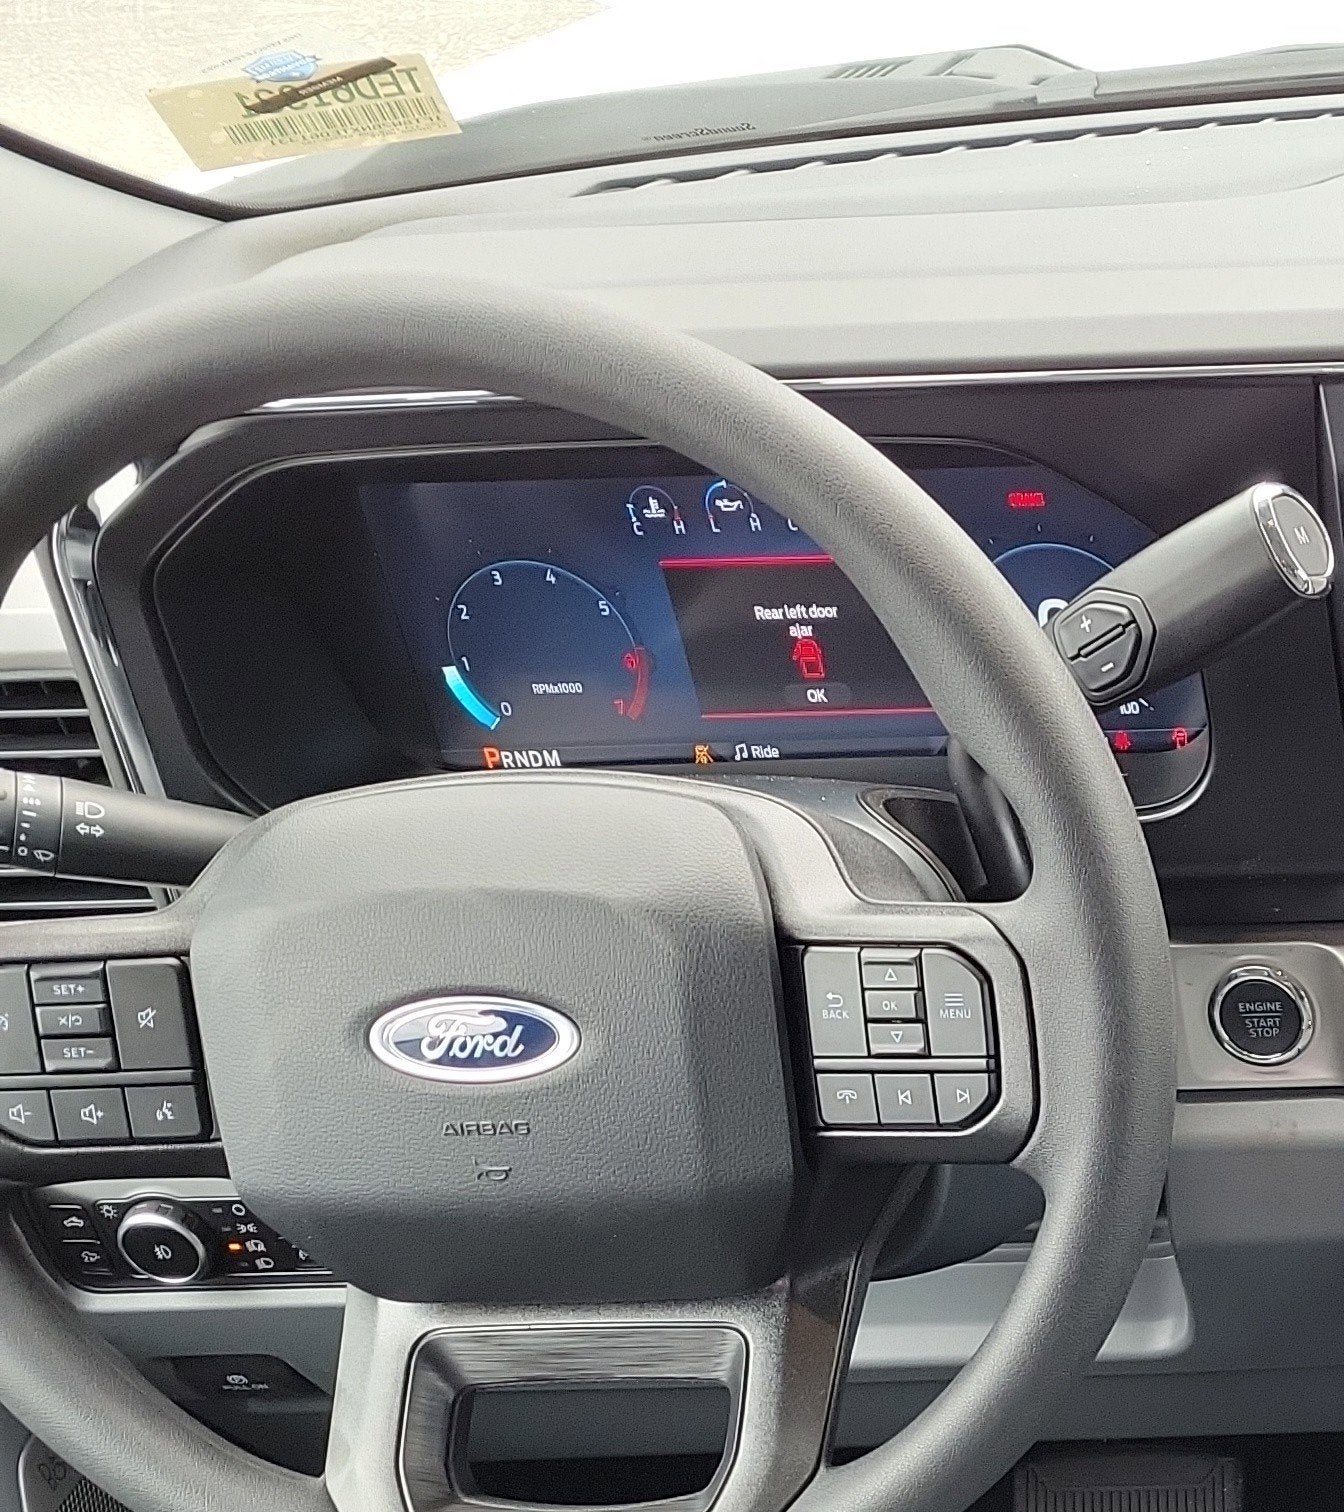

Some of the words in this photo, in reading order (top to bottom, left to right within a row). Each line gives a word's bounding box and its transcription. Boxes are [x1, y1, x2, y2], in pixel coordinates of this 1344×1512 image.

[1294, 526, 1310, 544] M
[491, 570, 502, 585] 3
[546, 571, 556, 584] 4
[457, 604, 469, 620] 2
[599, 601, 610, 615] 5
[754, 606, 784, 620] Rear
[785, 605, 808, 619] left
[809, 604, 838, 619] door
[789, 624, 813, 639] ajar
[462, 656, 470, 671] 1
[532, 682, 582, 694] RPMx1000
[807, 689, 828, 703] OK
[501, 702, 512, 716] 0
[751, 745, 779, 758] Ride
[53, 984, 86, 996] SET+
[882, 1001, 898, 1011] OK
[1238, 1002, 1283, 1012] ENGINE
[822, 1010, 849, 1019] BACK
[940, 1008, 971, 1019] MENU
[1245, 1018, 1280, 1028] START
[420, 1013, 524, 1062] Ford
[1250, 1028, 1279, 1037] STOP
[444, 1120, 530, 1136] AIRBAG
